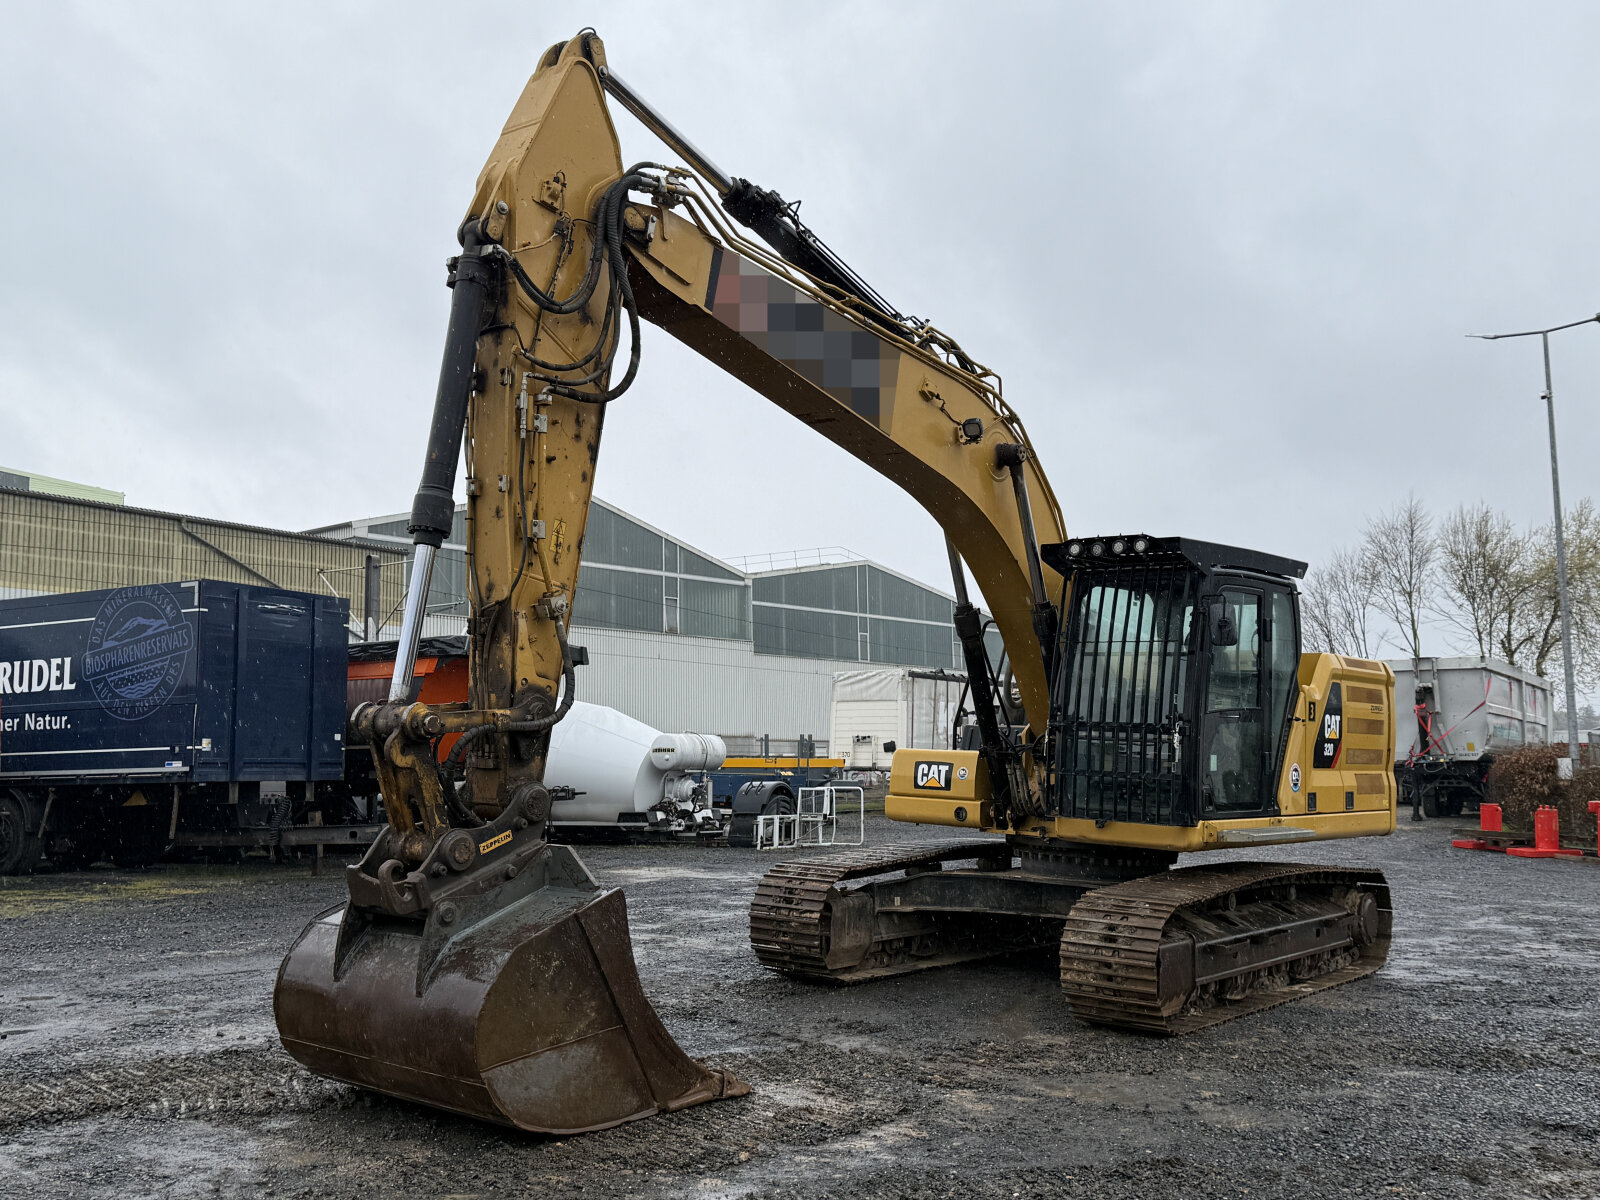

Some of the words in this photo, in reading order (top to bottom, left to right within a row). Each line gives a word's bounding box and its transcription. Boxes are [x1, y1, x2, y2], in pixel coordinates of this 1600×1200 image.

[91, 620, 106, 644] DAS
[85, 629, 189, 676] BIOSPHÄRENRESERVATS
[0, 657, 76, 694] RUDEL
[95, 681, 112, 704] AUS
[165, 661, 181, 685] DES
[24, 712, 71, 731] Natur.
[1324, 714, 1340, 739] CAT
[1324, 743, 1333, 756] 320
[917, 763, 949, 788] CAT
[482, 833, 511, 851] ZEPPELIN
